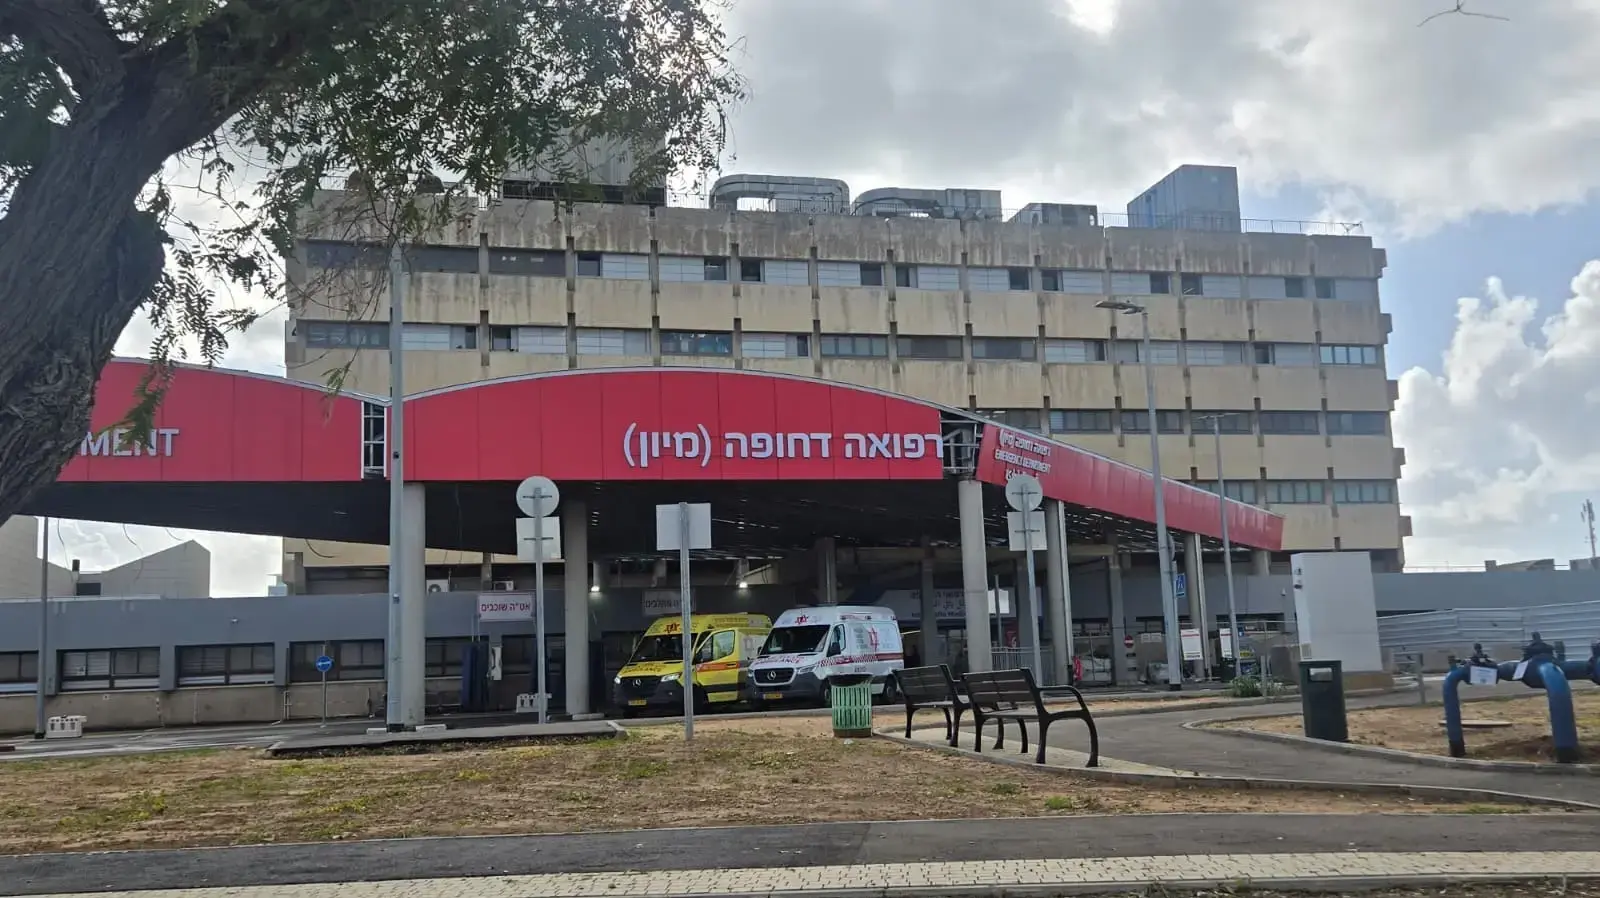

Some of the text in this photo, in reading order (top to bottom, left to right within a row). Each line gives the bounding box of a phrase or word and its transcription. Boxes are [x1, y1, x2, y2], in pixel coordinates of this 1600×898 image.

[623, 422, 945, 468] רפואה דחופה (מיון)
[481, 602, 508, 612] שוכבים
